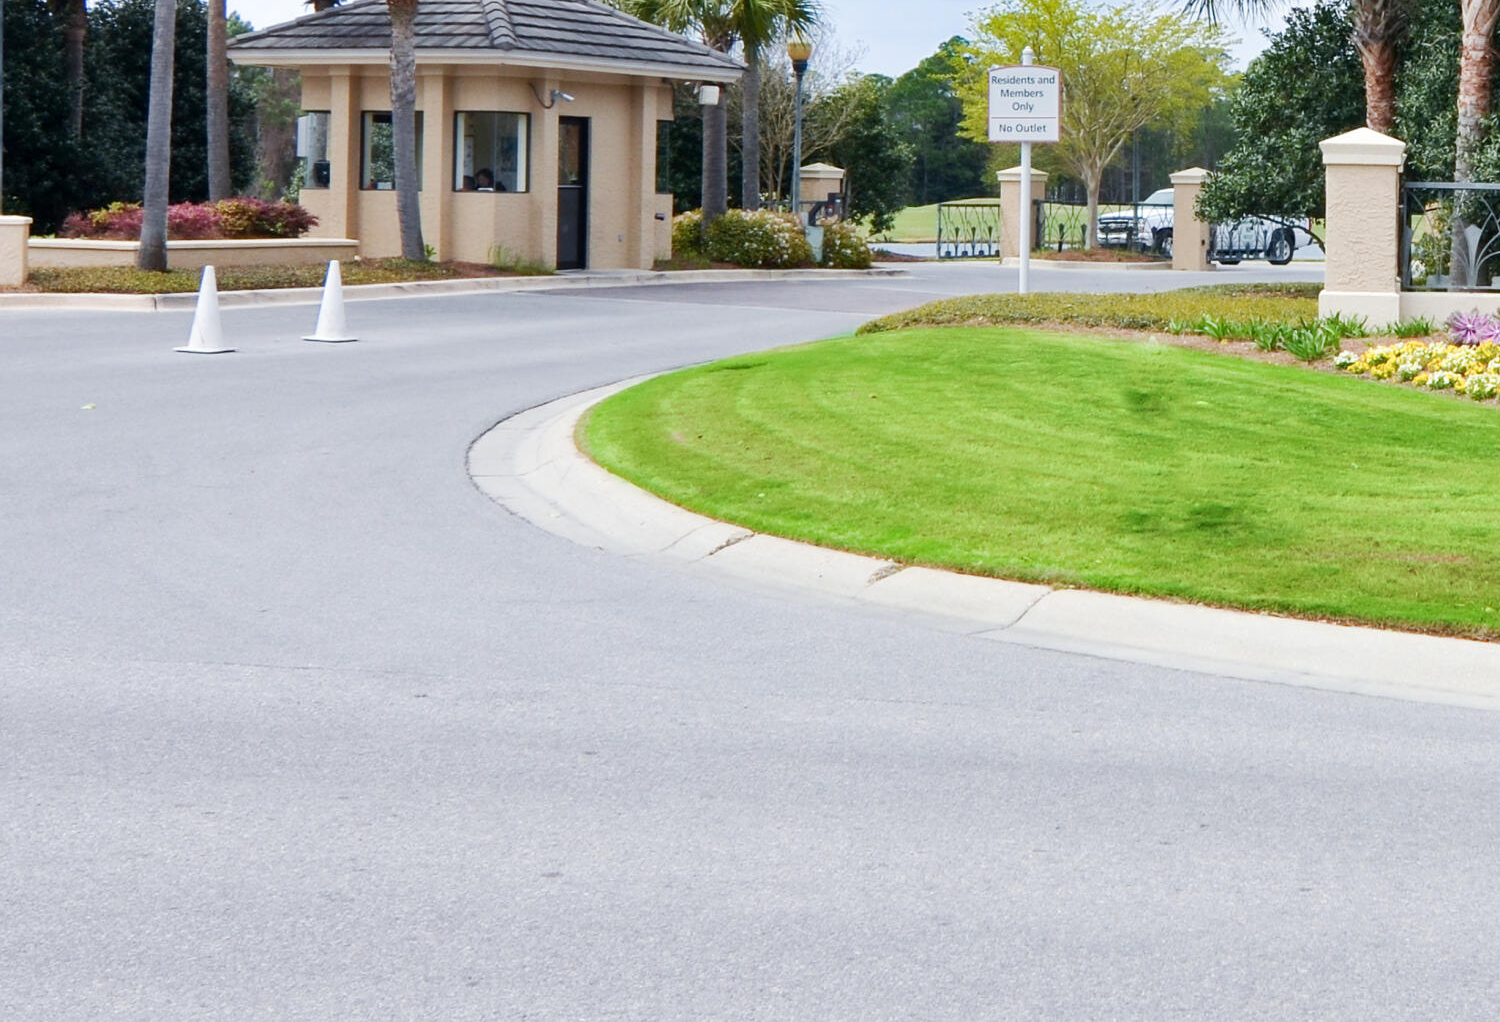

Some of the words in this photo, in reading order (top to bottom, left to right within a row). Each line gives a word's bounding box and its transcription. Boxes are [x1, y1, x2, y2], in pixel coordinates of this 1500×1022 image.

[991, 75, 1035, 85] Residents
[1037, 75, 1056, 85] and
[1000, 89, 1044, 98] Members
[1012, 102, 1034, 113] Only
[999, 124, 1013, 133] No
[1015, 123, 1046, 133] Outlet
